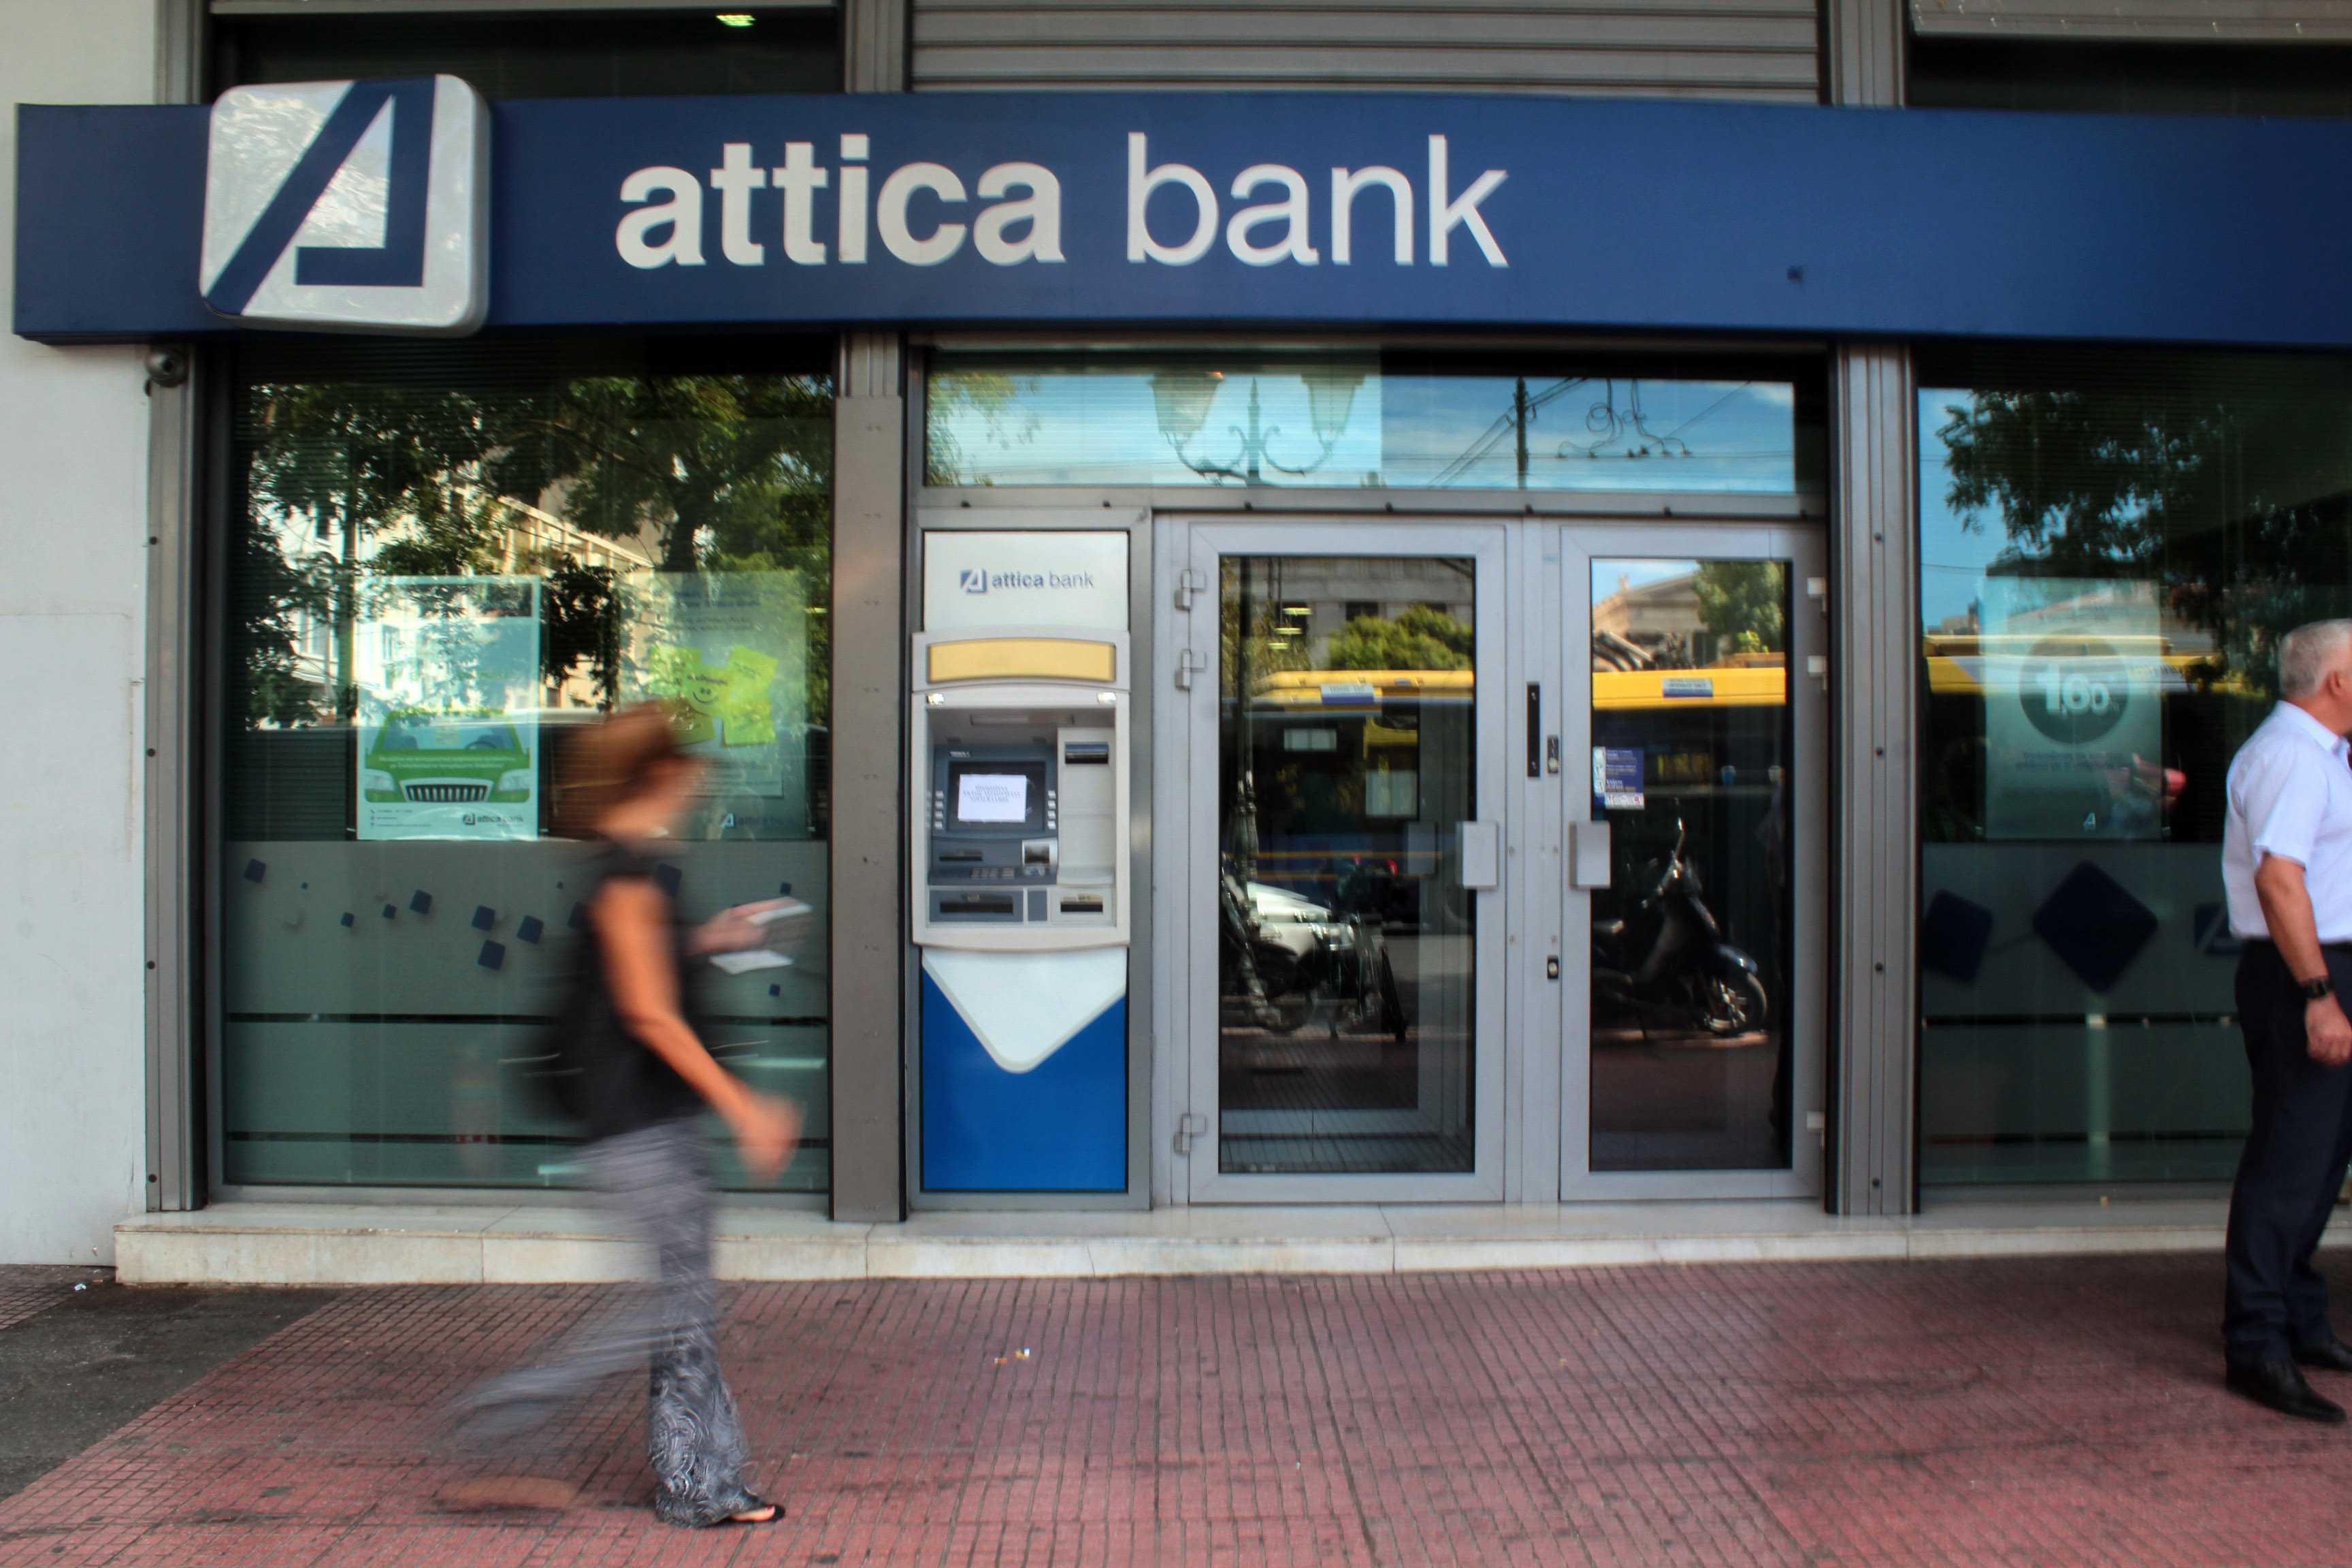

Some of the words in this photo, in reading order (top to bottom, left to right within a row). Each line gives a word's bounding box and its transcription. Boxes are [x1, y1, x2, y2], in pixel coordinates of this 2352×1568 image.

[616, 133, 1066, 268] attica
[1127, 132, 1508, 266] bank
[992, 572, 1044, 589] attica
[1049, 570, 1094, 589] bank
